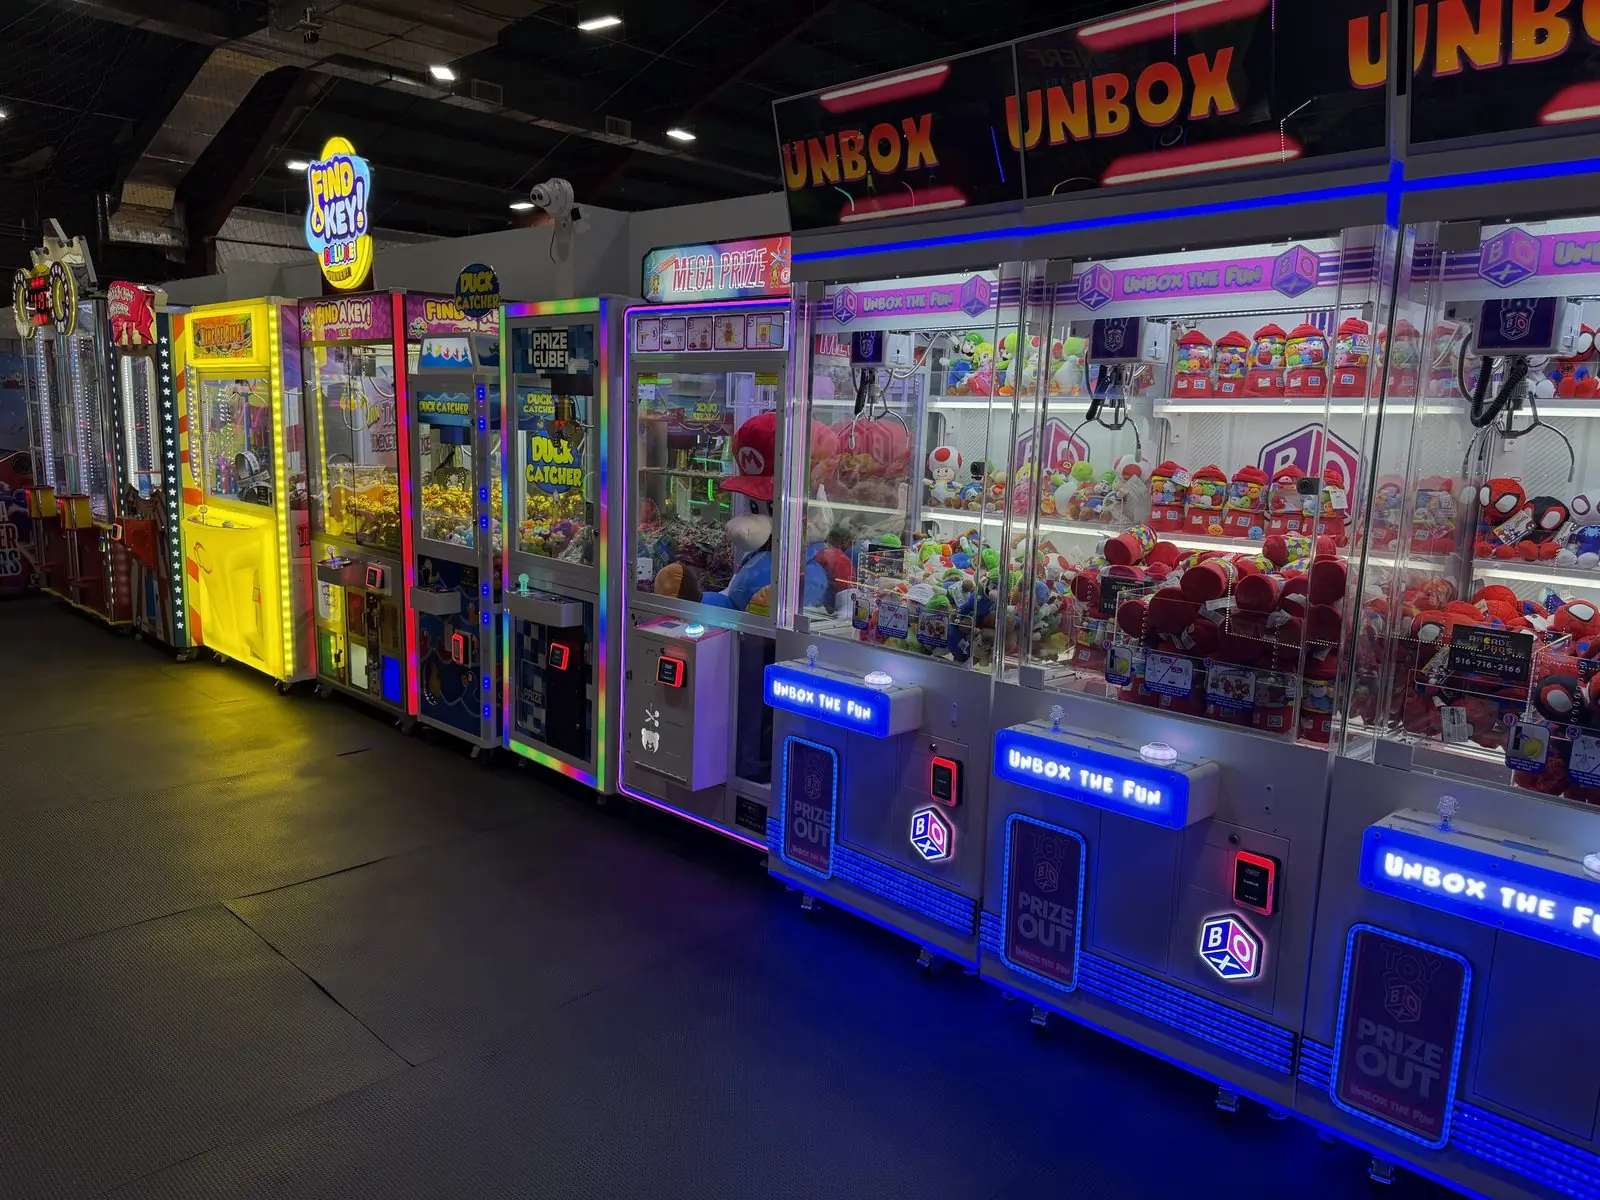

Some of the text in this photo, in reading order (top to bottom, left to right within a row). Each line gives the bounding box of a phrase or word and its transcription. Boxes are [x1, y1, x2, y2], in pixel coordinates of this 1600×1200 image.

[1004, 46, 1240, 151] UNBOX
[783, 113, 940, 191] UNBOX
[311, 161, 354, 205] FIND
[324, 181, 364, 239] KEY!
[324, 241, 356, 266] DELUXE
[460, 271, 494, 292] DUCK
[672, 254, 714, 292] MEGA
[719, 247, 768, 289] PRIZE
[1123, 265, 1262, 294] UNBOX THE FUN
[339, 302, 347, 322] A
[426, 301, 465, 321] FIND
[455, 293, 500, 310] CATCHER
[863, 291, 953, 312] UNBOX THE FUN
[533, 331, 568, 350] PRIZE
[533, 350, 565, 368] CUBE
[419, 400, 469, 415] DUCK CATCHER
[527, 393, 552, 405] DUCK
[531, 436, 574, 464] DUCK
[525, 463, 583, 487] CATCHER
[1469, 635, 1513, 647] ARCADE
[1484, 645, 1513, 655] PROS
[1455, 656, 1521, 673] 516-716-2166
[773, 680, 871, 720] UNBOX THE FUN
[1009, 749, 1161, 805] UNBOX THE FUN
[794, 800, 831, 827] PRIZE
[793, 816, 830, 849] OUT
[1384, 852, 1556, 919] UNBOX THE
[1019, 891, 1074, 929] PRIZE
[1017, 911, 1073, 953] OUT
[1356, 1016, 1444, 1071] PRIZE
[1355, 1044, 1440, 1099] OUT
